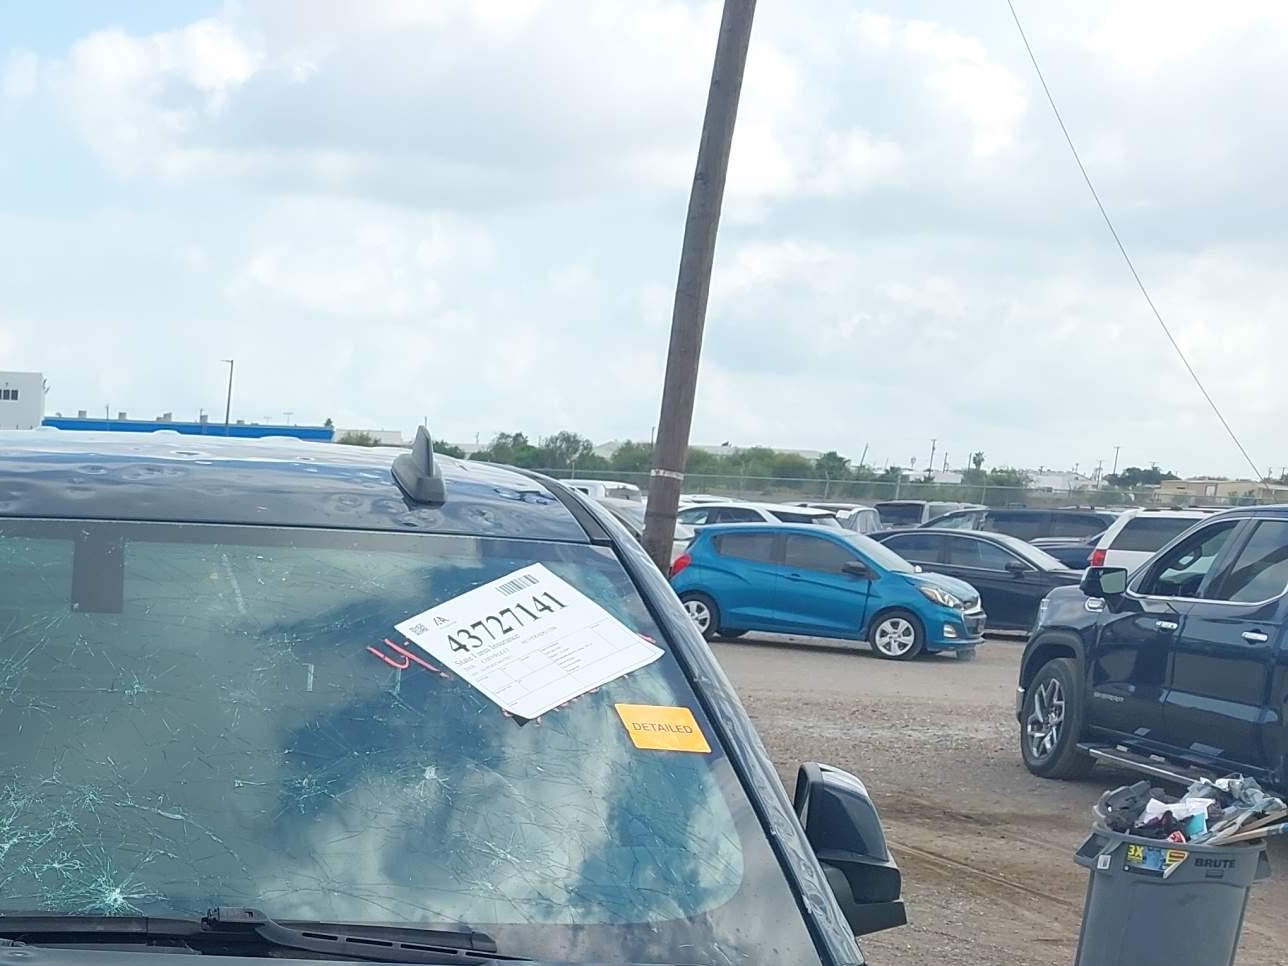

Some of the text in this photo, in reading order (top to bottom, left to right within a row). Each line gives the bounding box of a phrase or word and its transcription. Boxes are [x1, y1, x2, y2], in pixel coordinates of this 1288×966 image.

[448, 591, 567, 652] 43727141
[632, 722, 693, 734] DETAILED
[1128, 844, 1144, 858] 3X
[1195, 858, 1236, 869] BRUTE
